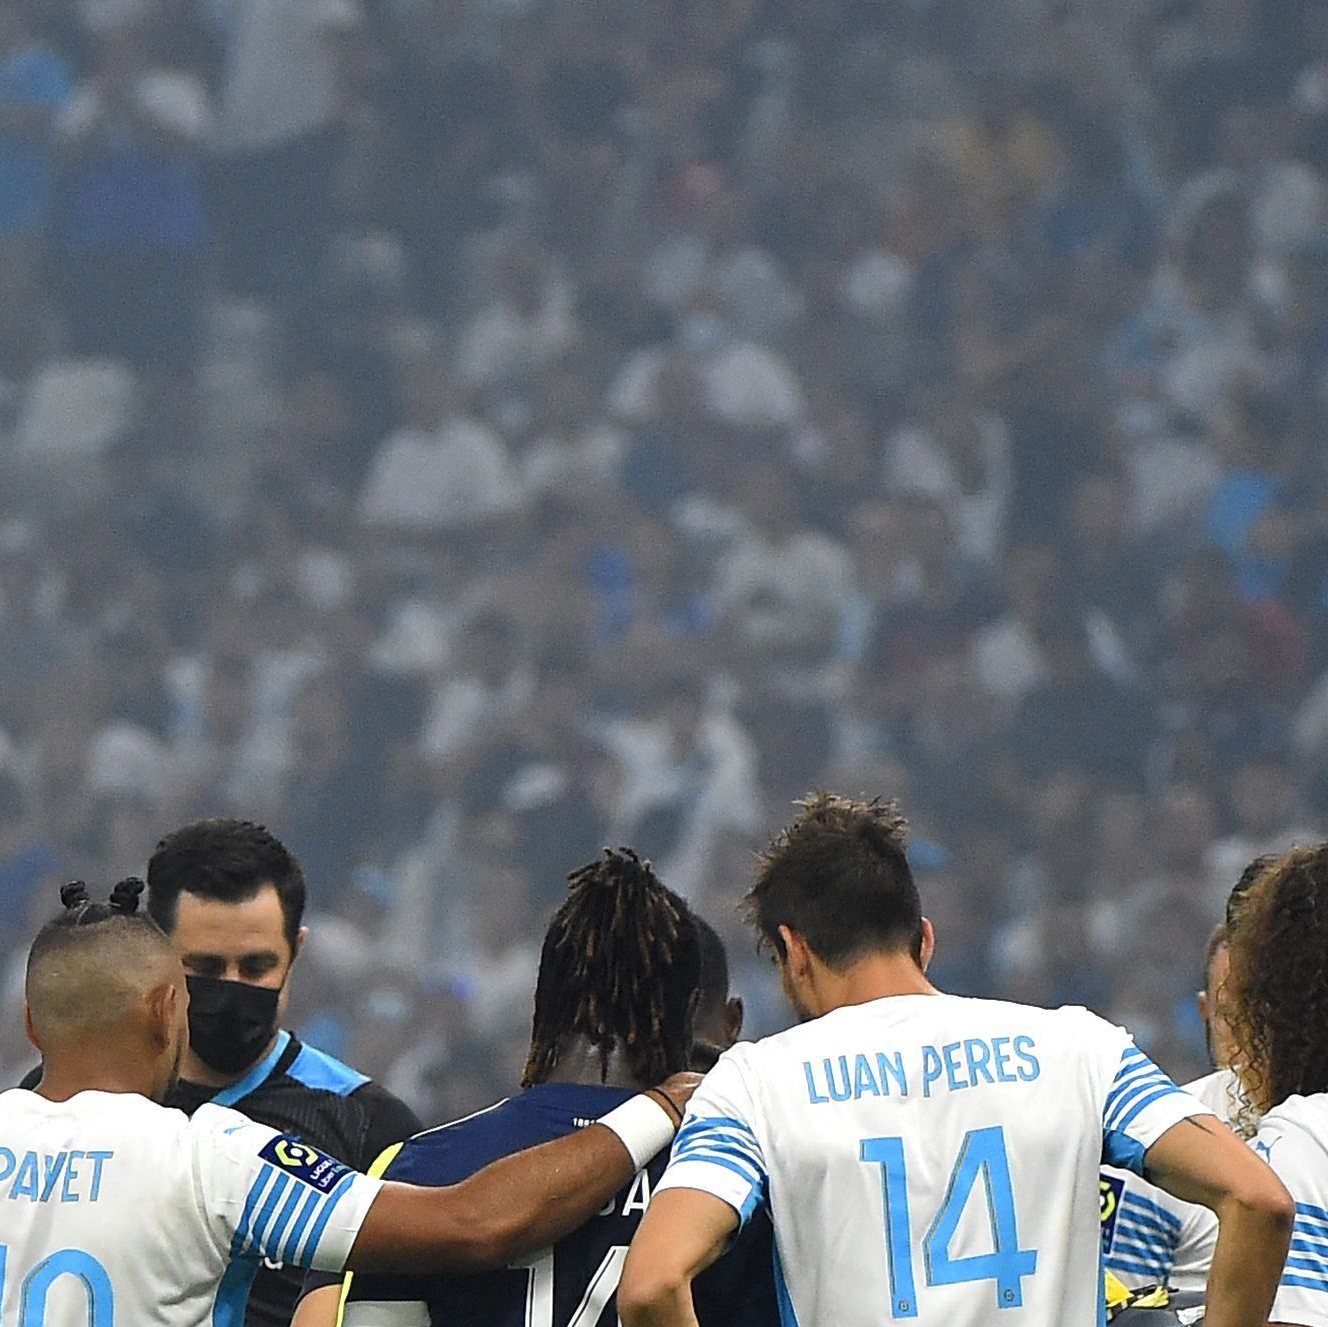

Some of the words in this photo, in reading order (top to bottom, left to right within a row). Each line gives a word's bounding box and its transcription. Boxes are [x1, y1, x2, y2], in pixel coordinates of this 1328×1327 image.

[802, 1051, 908, 1104] LUAN
[921, 1035, 1040, 1098] PERES
[859, 1125, 1038, 1320] 14
